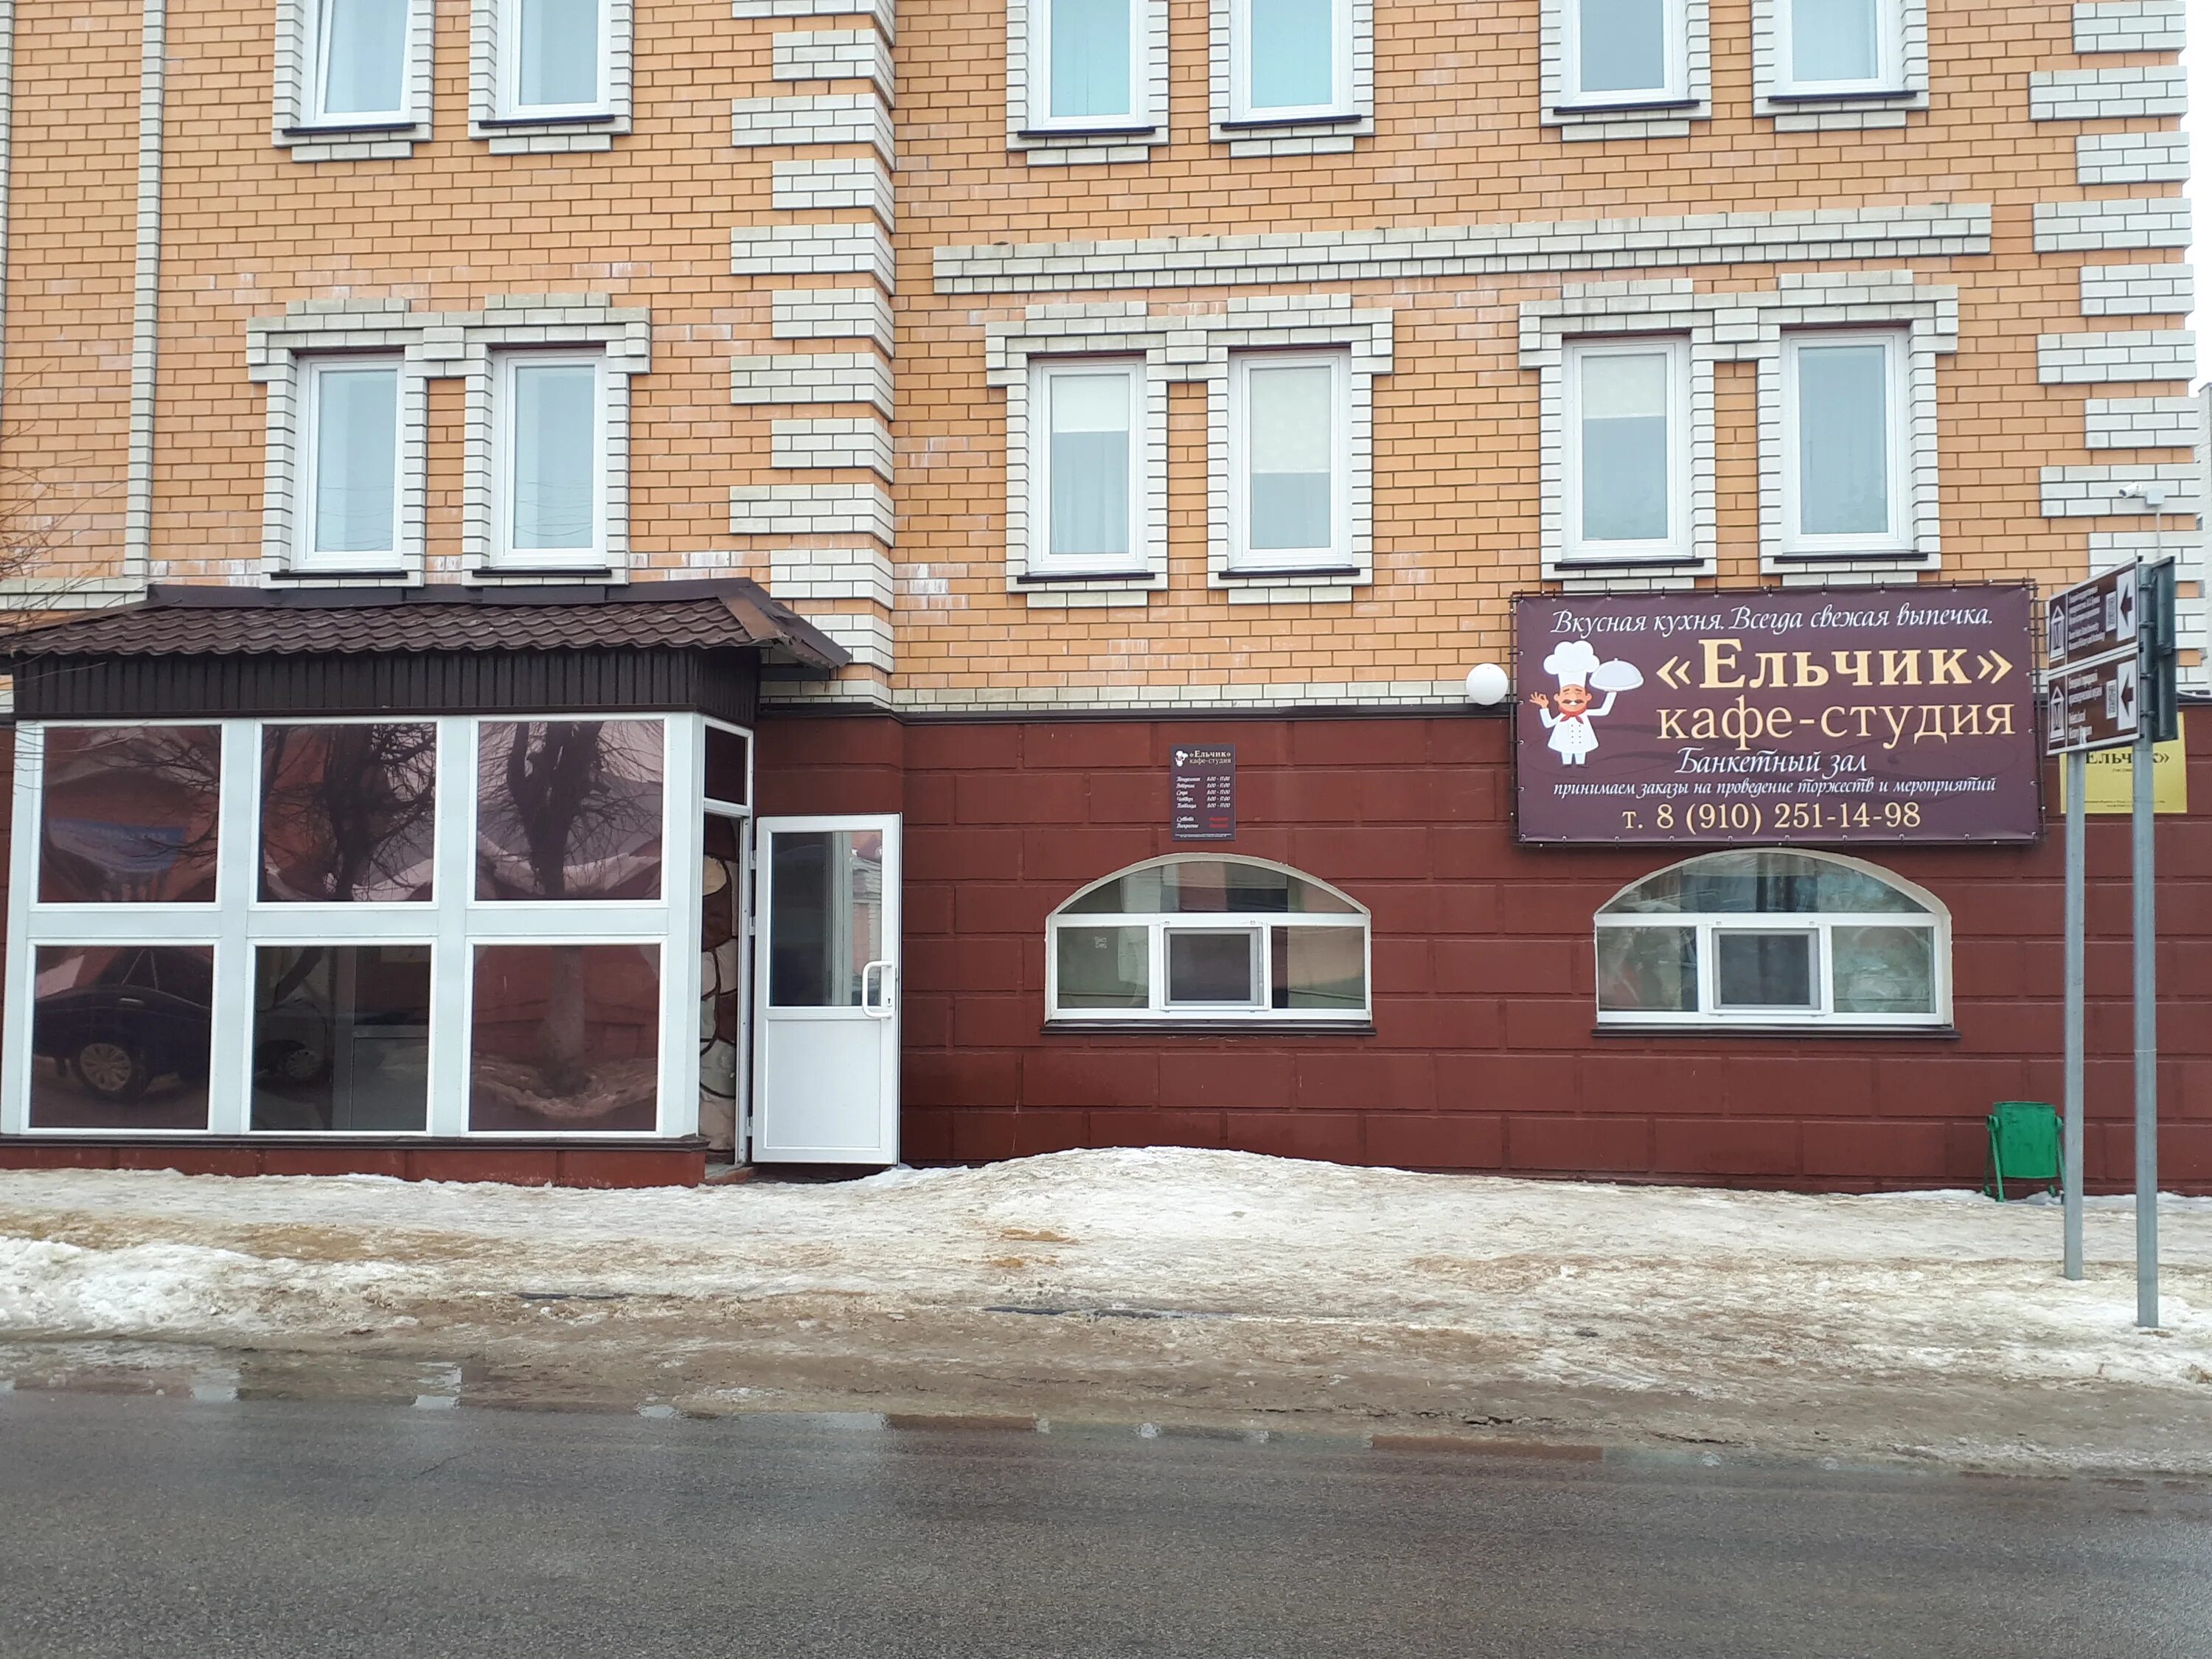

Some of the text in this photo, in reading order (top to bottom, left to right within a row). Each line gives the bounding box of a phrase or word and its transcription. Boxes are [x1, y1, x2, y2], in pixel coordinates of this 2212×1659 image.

[1551, 602, 1993, 639] Вкусная кухня. Всегда свежая выпечка.
[1655, 638, 2014, 690] «Ельчик»
[1656, 694, 2016, 751] кафе-студия
[1674, 747, 1868, 780] Банкетный зал
[1554, 776, 1997, 799] принимаем заказы на проведение торжеств и мероприятий
[1622, 801, 1921, 835] т. 8 (910) 251-14-98
